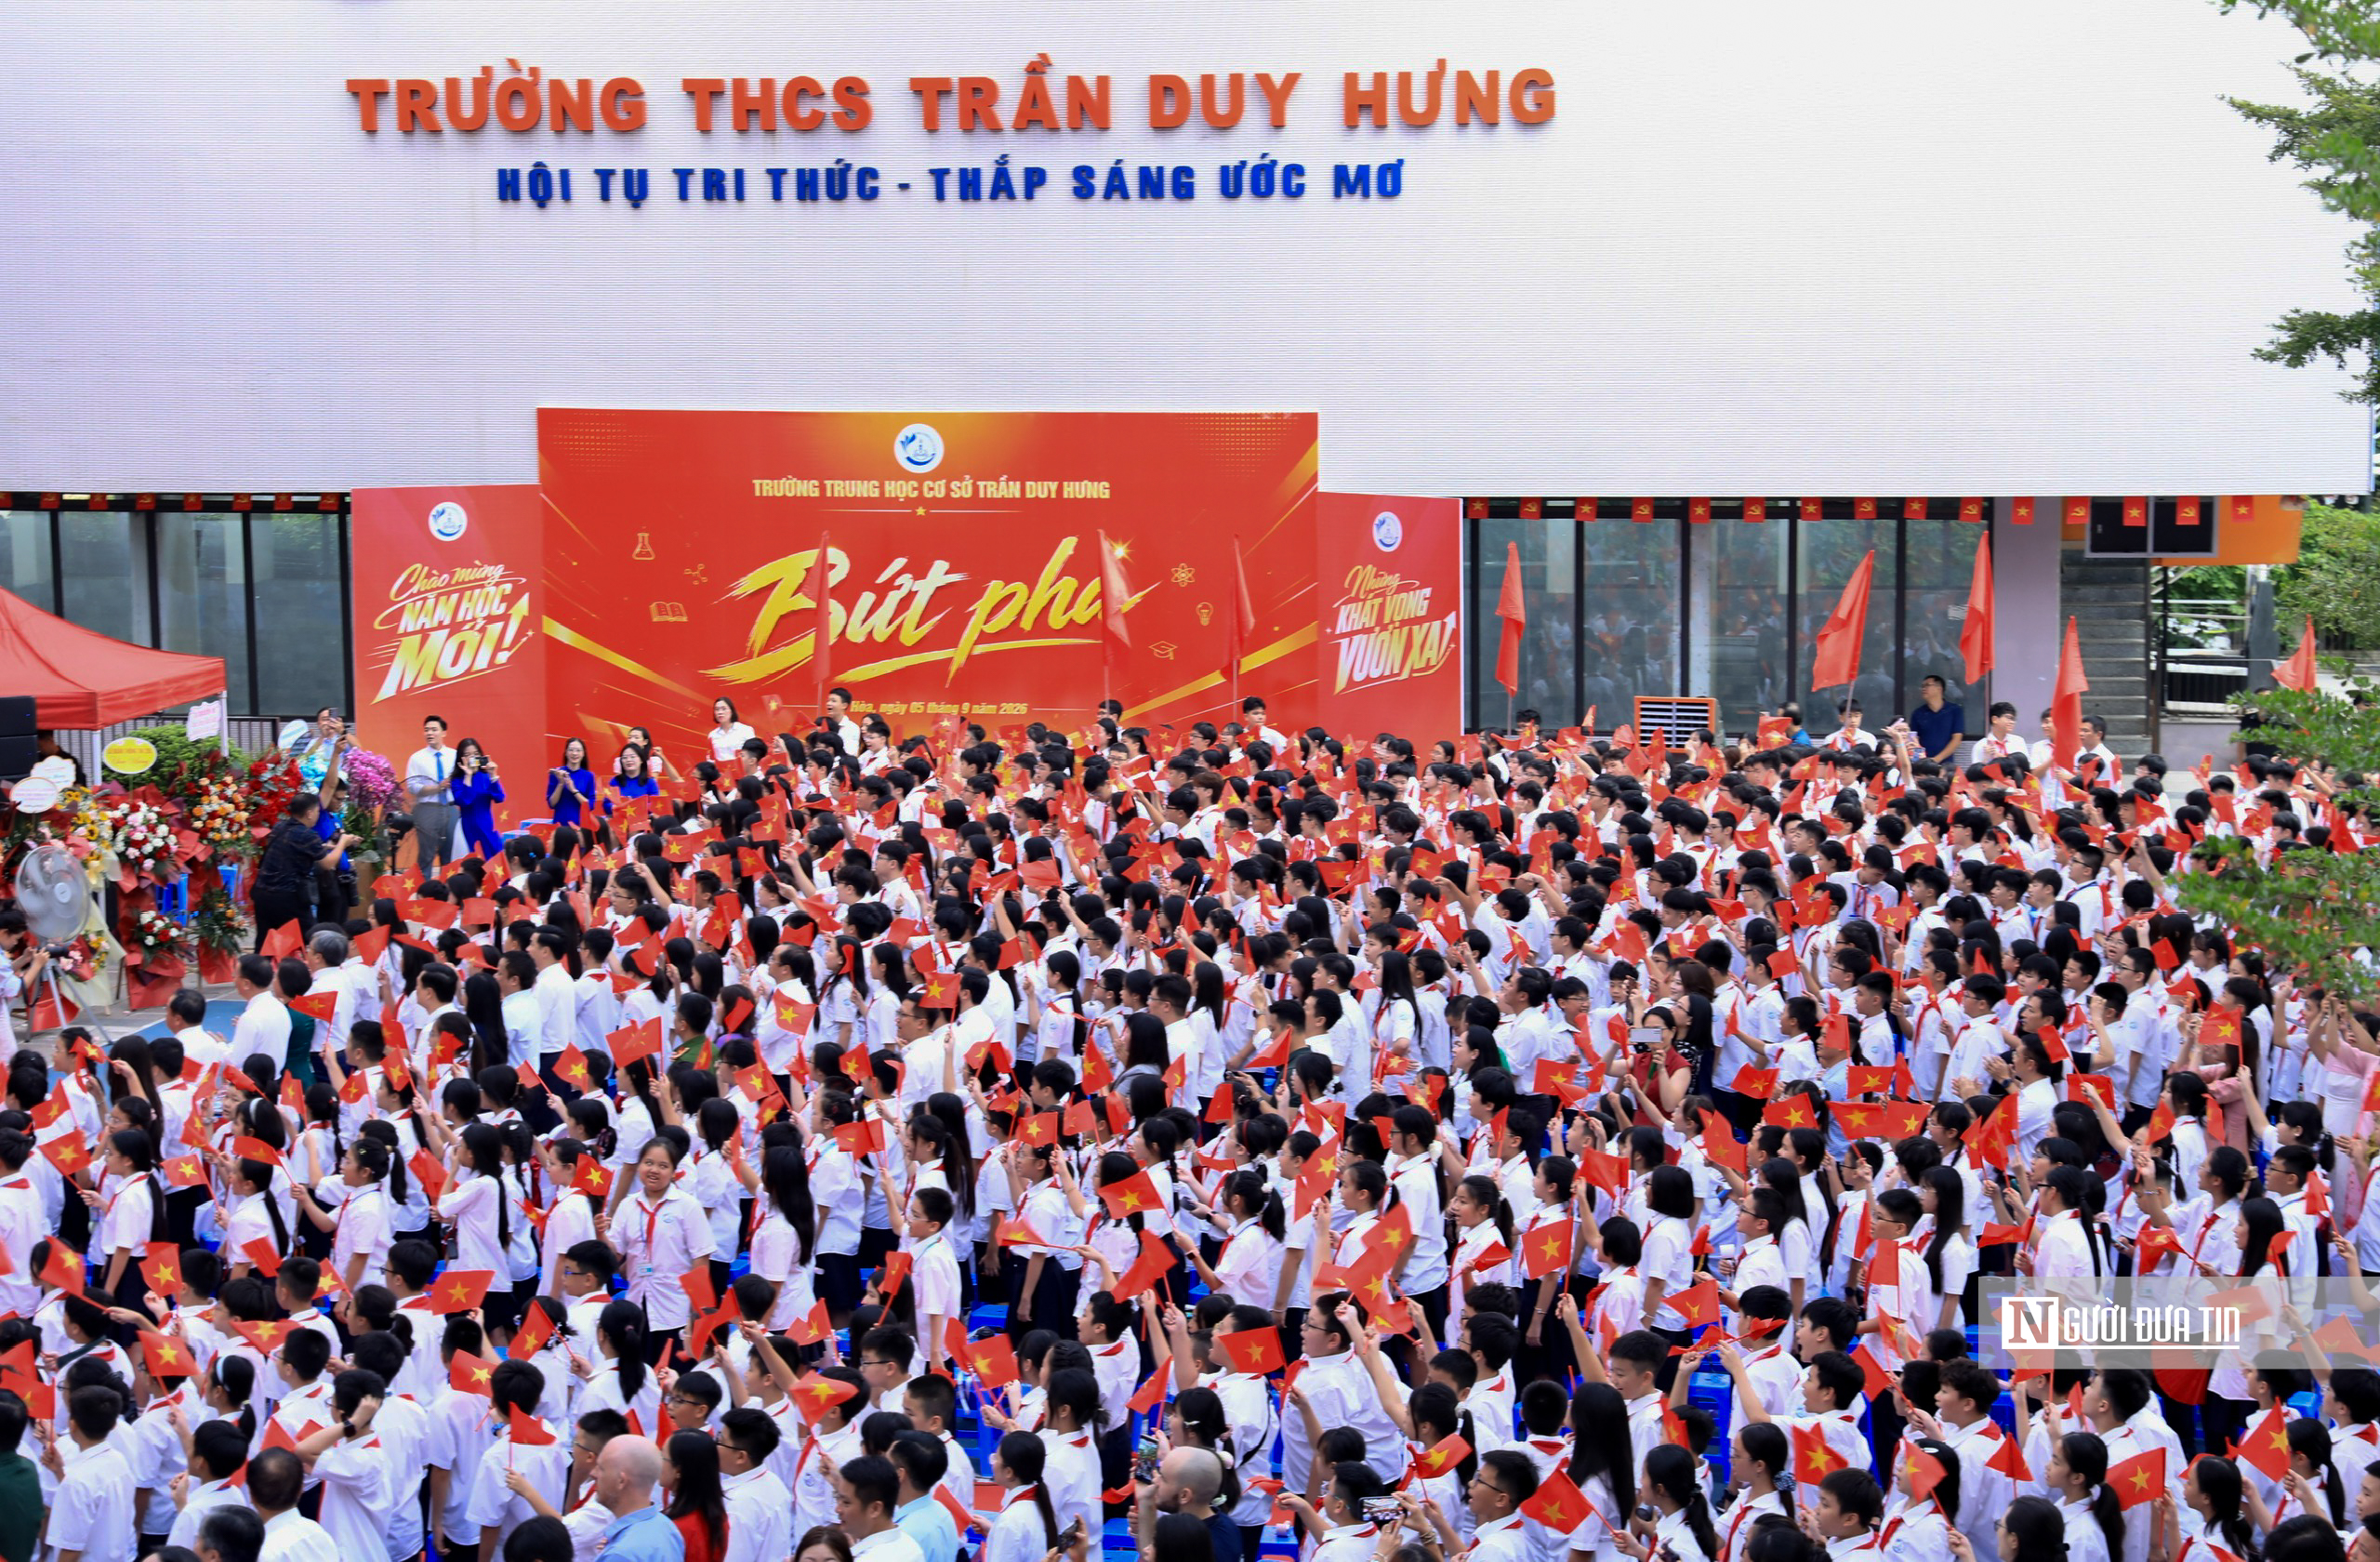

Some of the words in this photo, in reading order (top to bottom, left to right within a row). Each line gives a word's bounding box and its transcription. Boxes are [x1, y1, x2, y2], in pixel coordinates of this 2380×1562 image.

[347, 58, 648, 132] TRƯỜNG
[682, 75, 875, 132] THCS
[910, 53, 1113, 132] TRẦN
[1149, 73, 1302, 129] DUY
[1343, 59, 1557, 128] HƯNG
[497, 161, 572, 207] HỘI
[595, 168, 650, 208] TỤ
[673, 168, 746, 201] TRI
[766, 158, 881, 201] THỨC
[930, 154, 1048, 201] THẮP
[1072, 160, 1197, 201] SÁNG
[1220, 153, 1307, 200] ƯỚC
[1333, 158, 1405, 199] MƠ
[752, 476, 820, 497] TRƯỜNG
[824, 480, 879, 497] TRUNG
[884, 481, 919, 502] HỌC
[924, 480, 947, 498] CƠ
[950, 475, 973, 498] SỞ
[976, 475, 1021, 499] TRẦN
[1025, 482, 1059, 499] DUY
[1063, 481, 1111, 499] HƯNG
[390, 563, 450, 602] Chào
[451, 560, 509, 587] mừng
[1344, 564, 1401, 599] Những
[397, 592, 460, 635] NĂM
[456, 583, 513, 621] HỌC
[699, 547, 971, 686] Bứt
[1335, 592, 1383, 635] KHÁT
[1383, 587, 1432, 626] VỌNG
[1332, 626, 1411, 695] VƯƠN
[879, 701, 908, 715] ngày
[909, 702, 925, 714] 05
[927, 701, 959, 715] tháng
[961, 703, 970, 714] 9
[972, 701, 998, 714] năm
